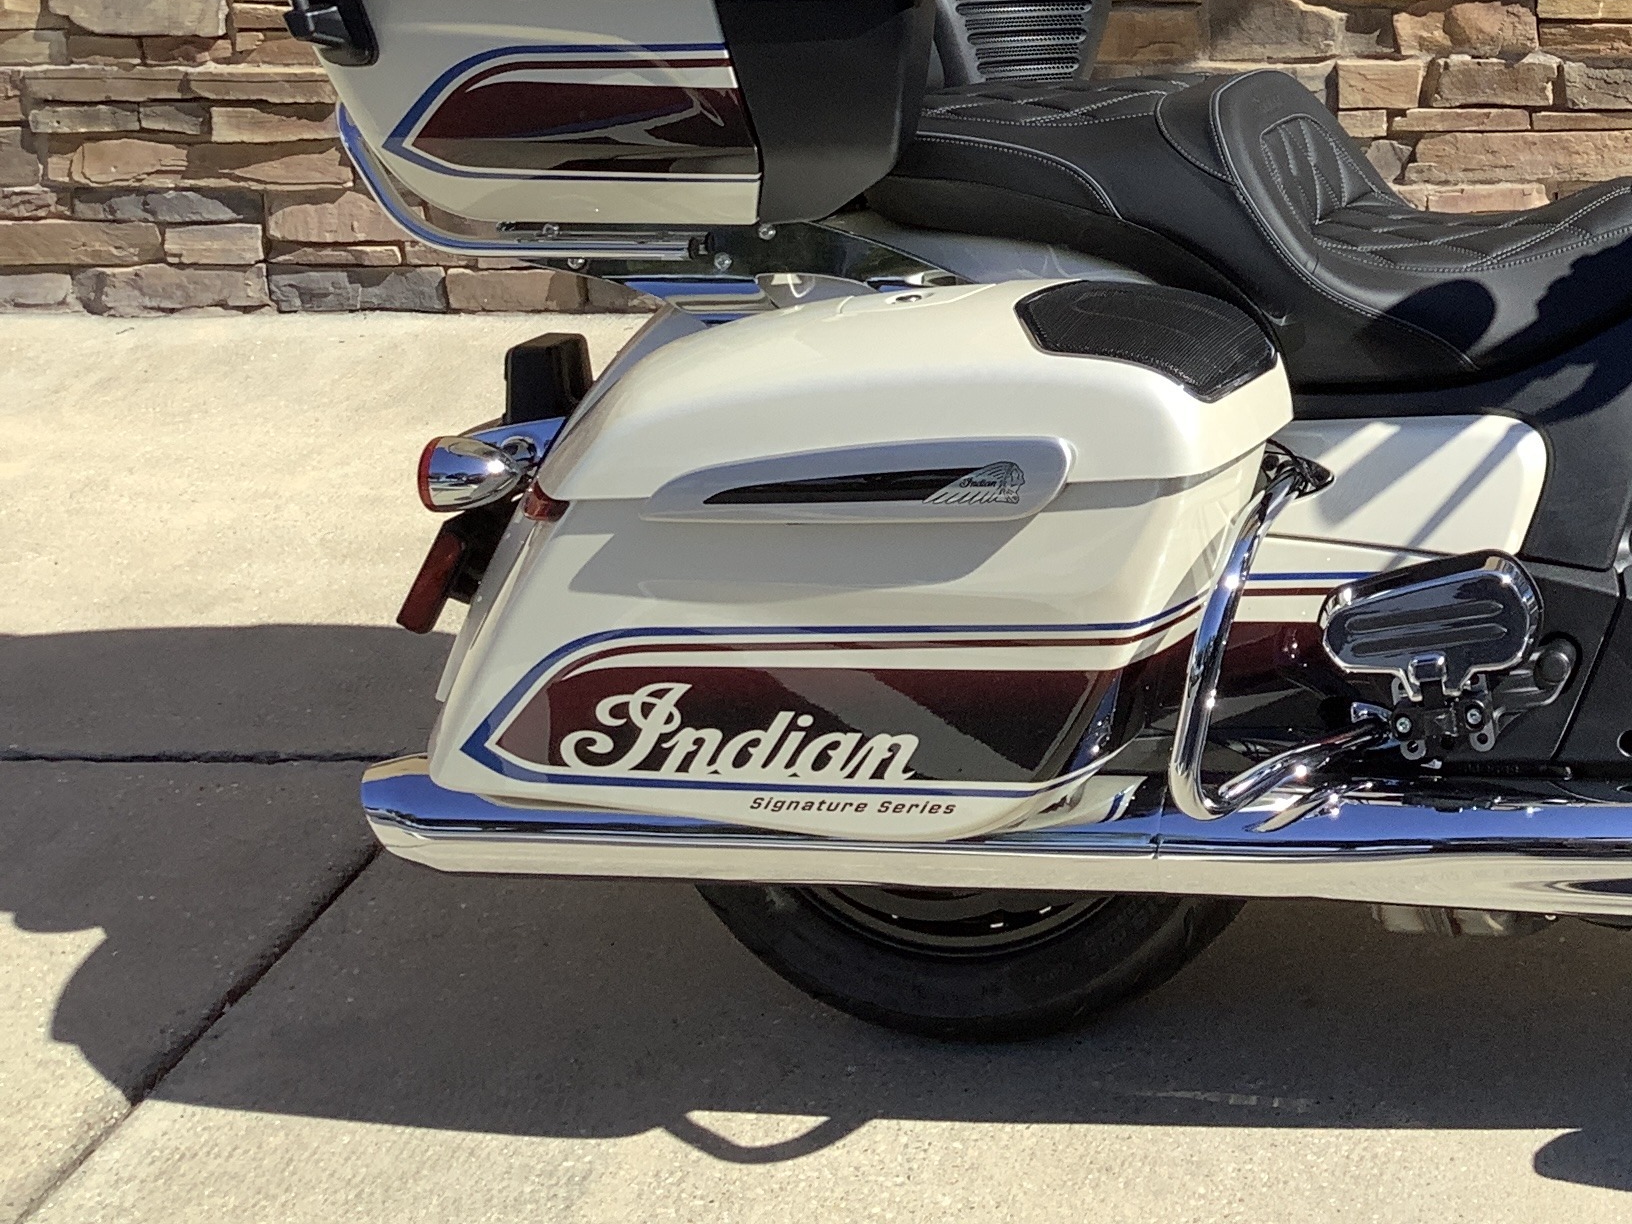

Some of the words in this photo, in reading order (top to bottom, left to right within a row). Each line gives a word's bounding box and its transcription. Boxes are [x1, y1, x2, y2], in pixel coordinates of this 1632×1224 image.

[959, 476, 997, 488] Indian
[560, 682, 920, 782] Indian
[750, 797, 868, 813] Signature
[877, 801, 957, 815] Series
